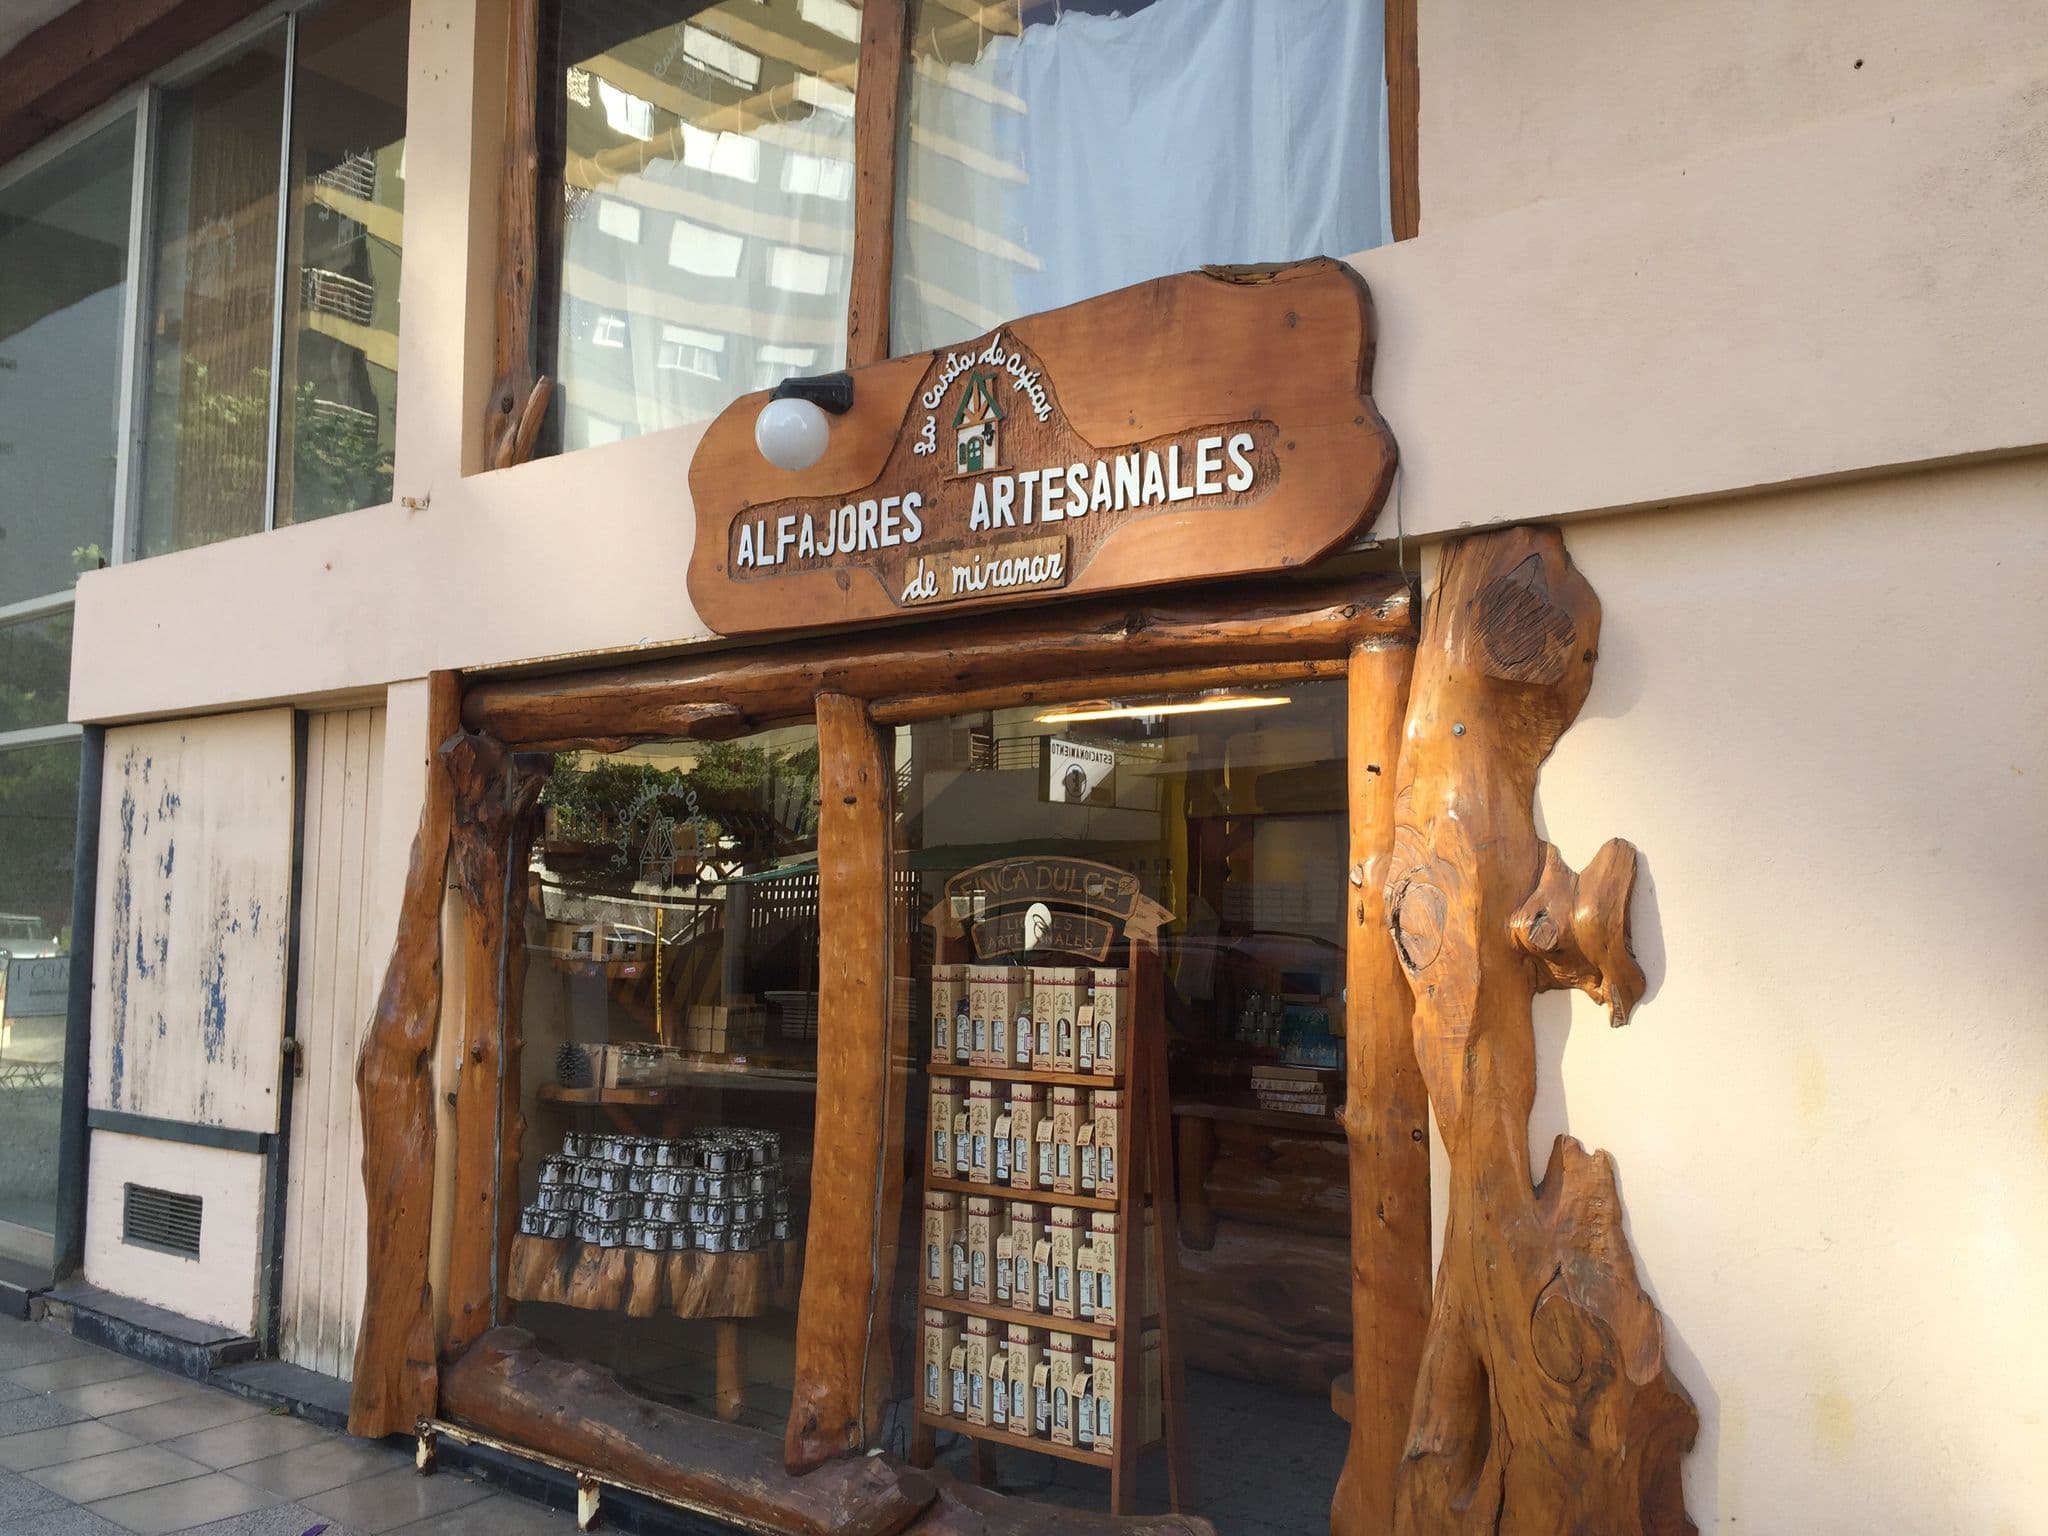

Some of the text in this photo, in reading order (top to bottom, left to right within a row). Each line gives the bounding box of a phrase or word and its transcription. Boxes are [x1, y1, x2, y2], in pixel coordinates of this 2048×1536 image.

[978, 332, 1007, 366] de
[923, 352, 976, 410] Casita
[914, 416, 937, 457] La
[736, 432, 1256, 568] ALFAJORES ARTESANALES
[901, 550, 1065, 601] de miramar
[959, 864, 1029, 898] FINCA
[1035, 865, 1120, 904] DULCE
[987, 931, 1096, 951] ARTEANALES
